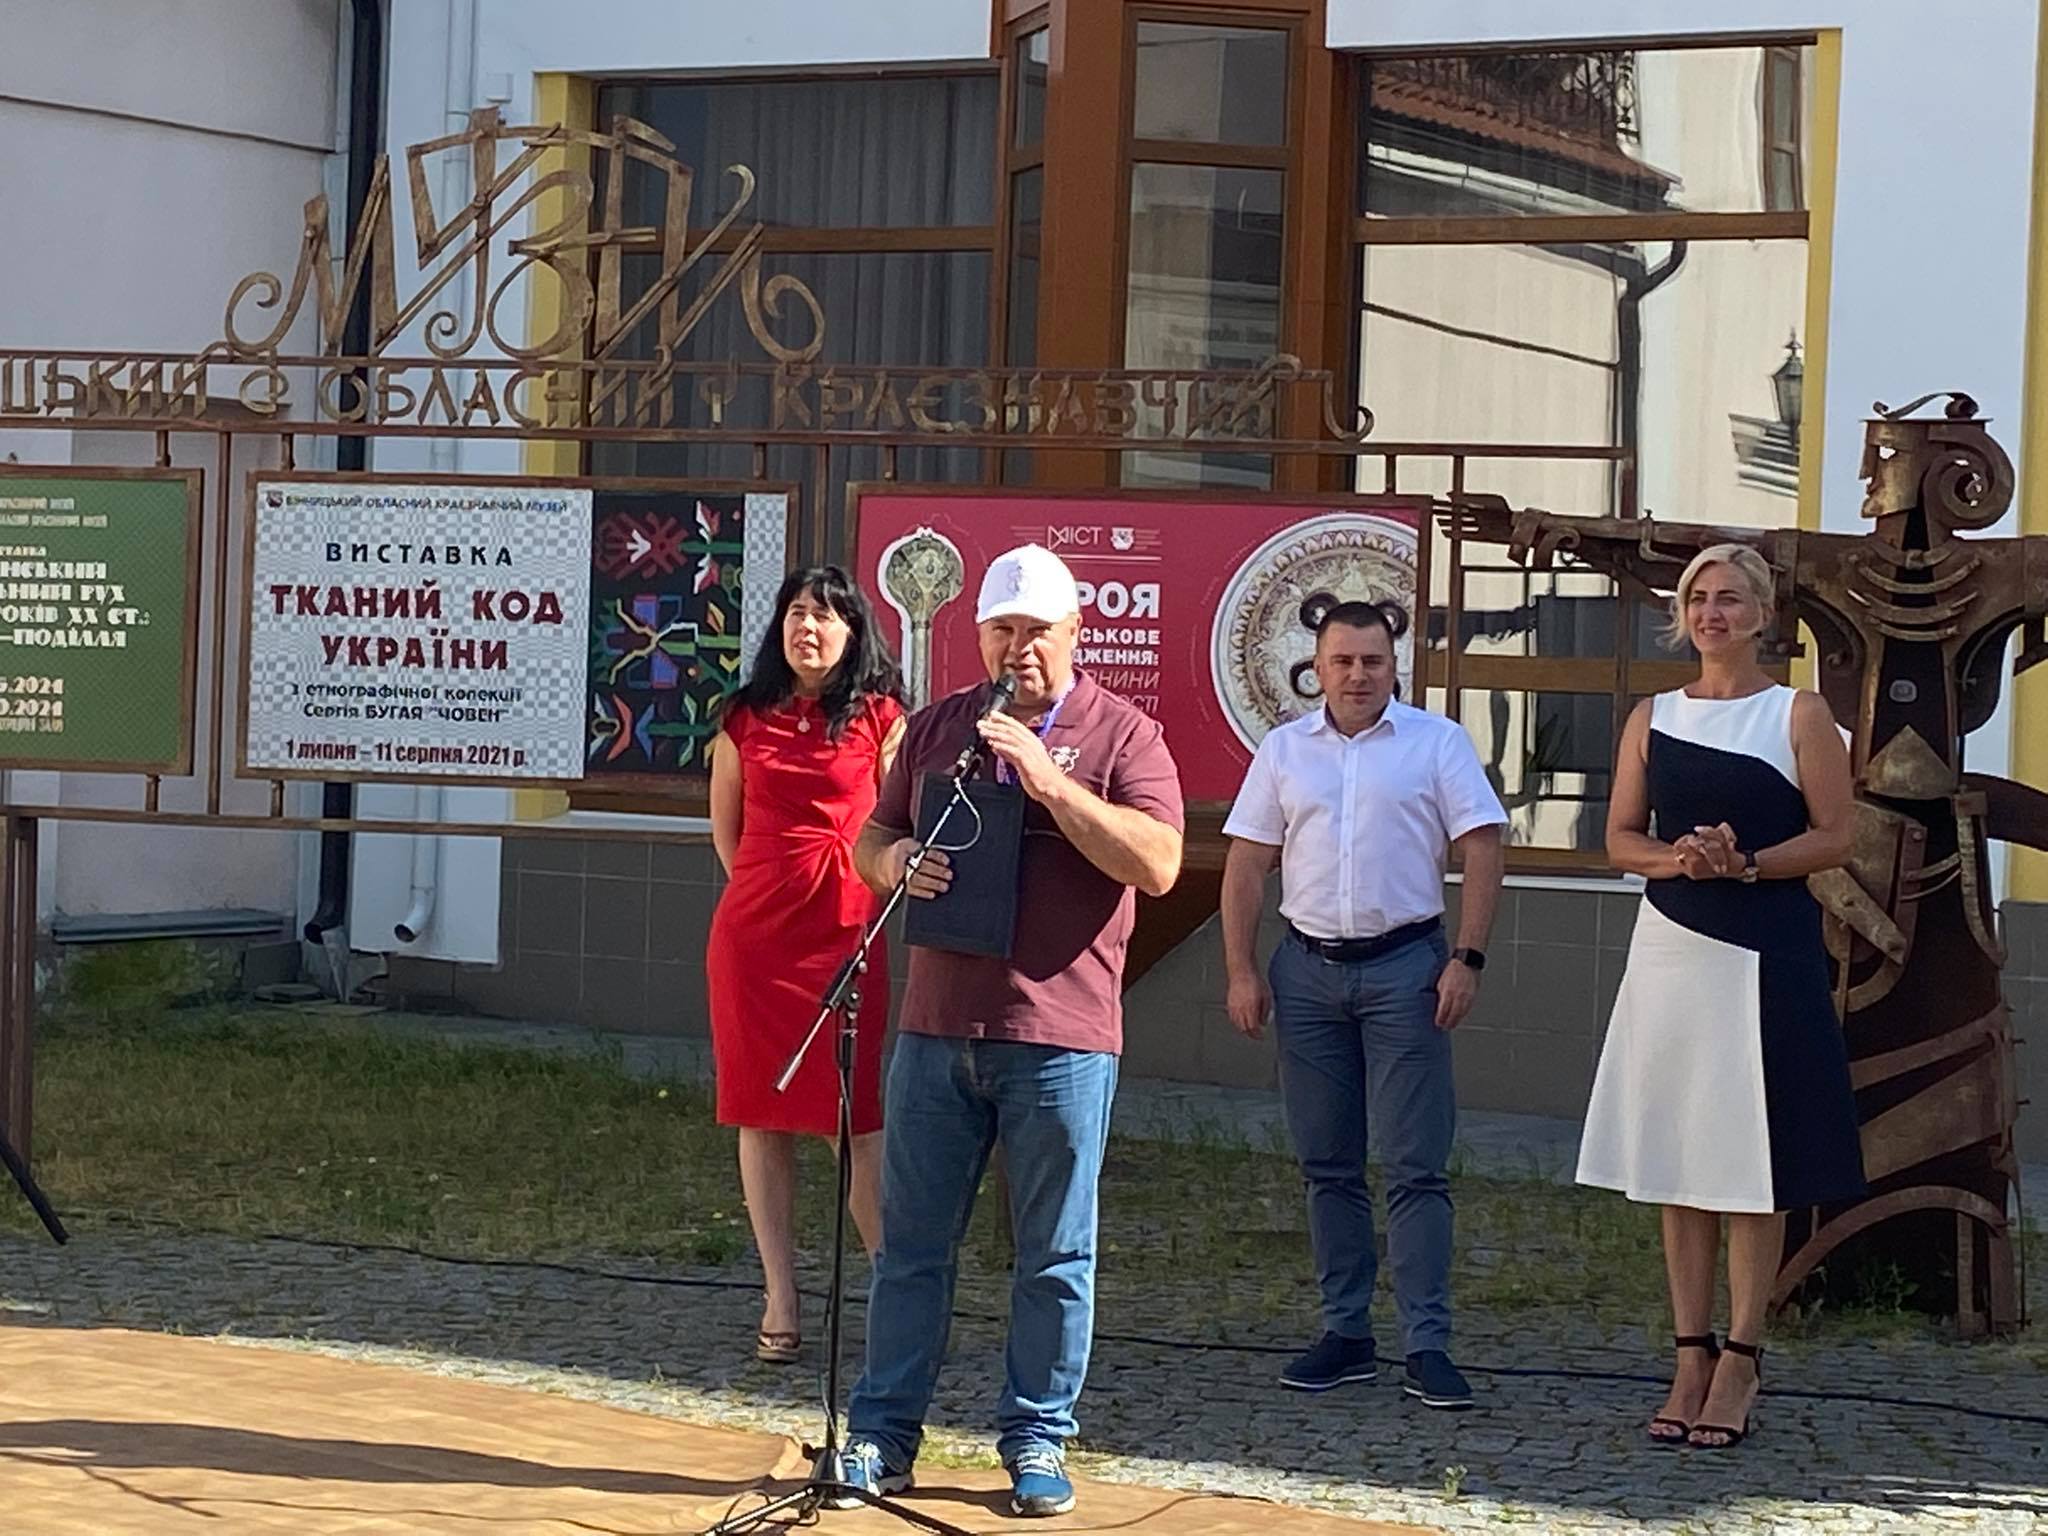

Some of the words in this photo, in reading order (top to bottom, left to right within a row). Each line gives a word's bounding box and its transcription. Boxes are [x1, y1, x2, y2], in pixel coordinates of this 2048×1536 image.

[320, 350, 675, 429] ОБЛАСНИЙ
[772, 358, 1300, 438] КРАЄЗНАВЧИЙ
[326, 543, 513, 566] ВИСТАВКА
[80, 584, 125, 605] РУХ
[269, 579, 442, 619] ТКАНИЙ
[473, 589, 564, 624] КОД
[0, 604, 58, 623] ОКІВ
[321, 628, 508, 670] УКРАЇНИ
[306, 683, 438, 702] етнографічної
[445, 686, 522, 704] колекції
[303, 702, 359, 719] Сергія
[365, 705, 422, 721] БУГАЯ
[286, 740, 294, 758] 1
[297, 742, 356, 760] липня
[376, 742, 392, 761] 11
[395, 745, 463, 764] серпня
[467, 745, 509, 764] 2021
